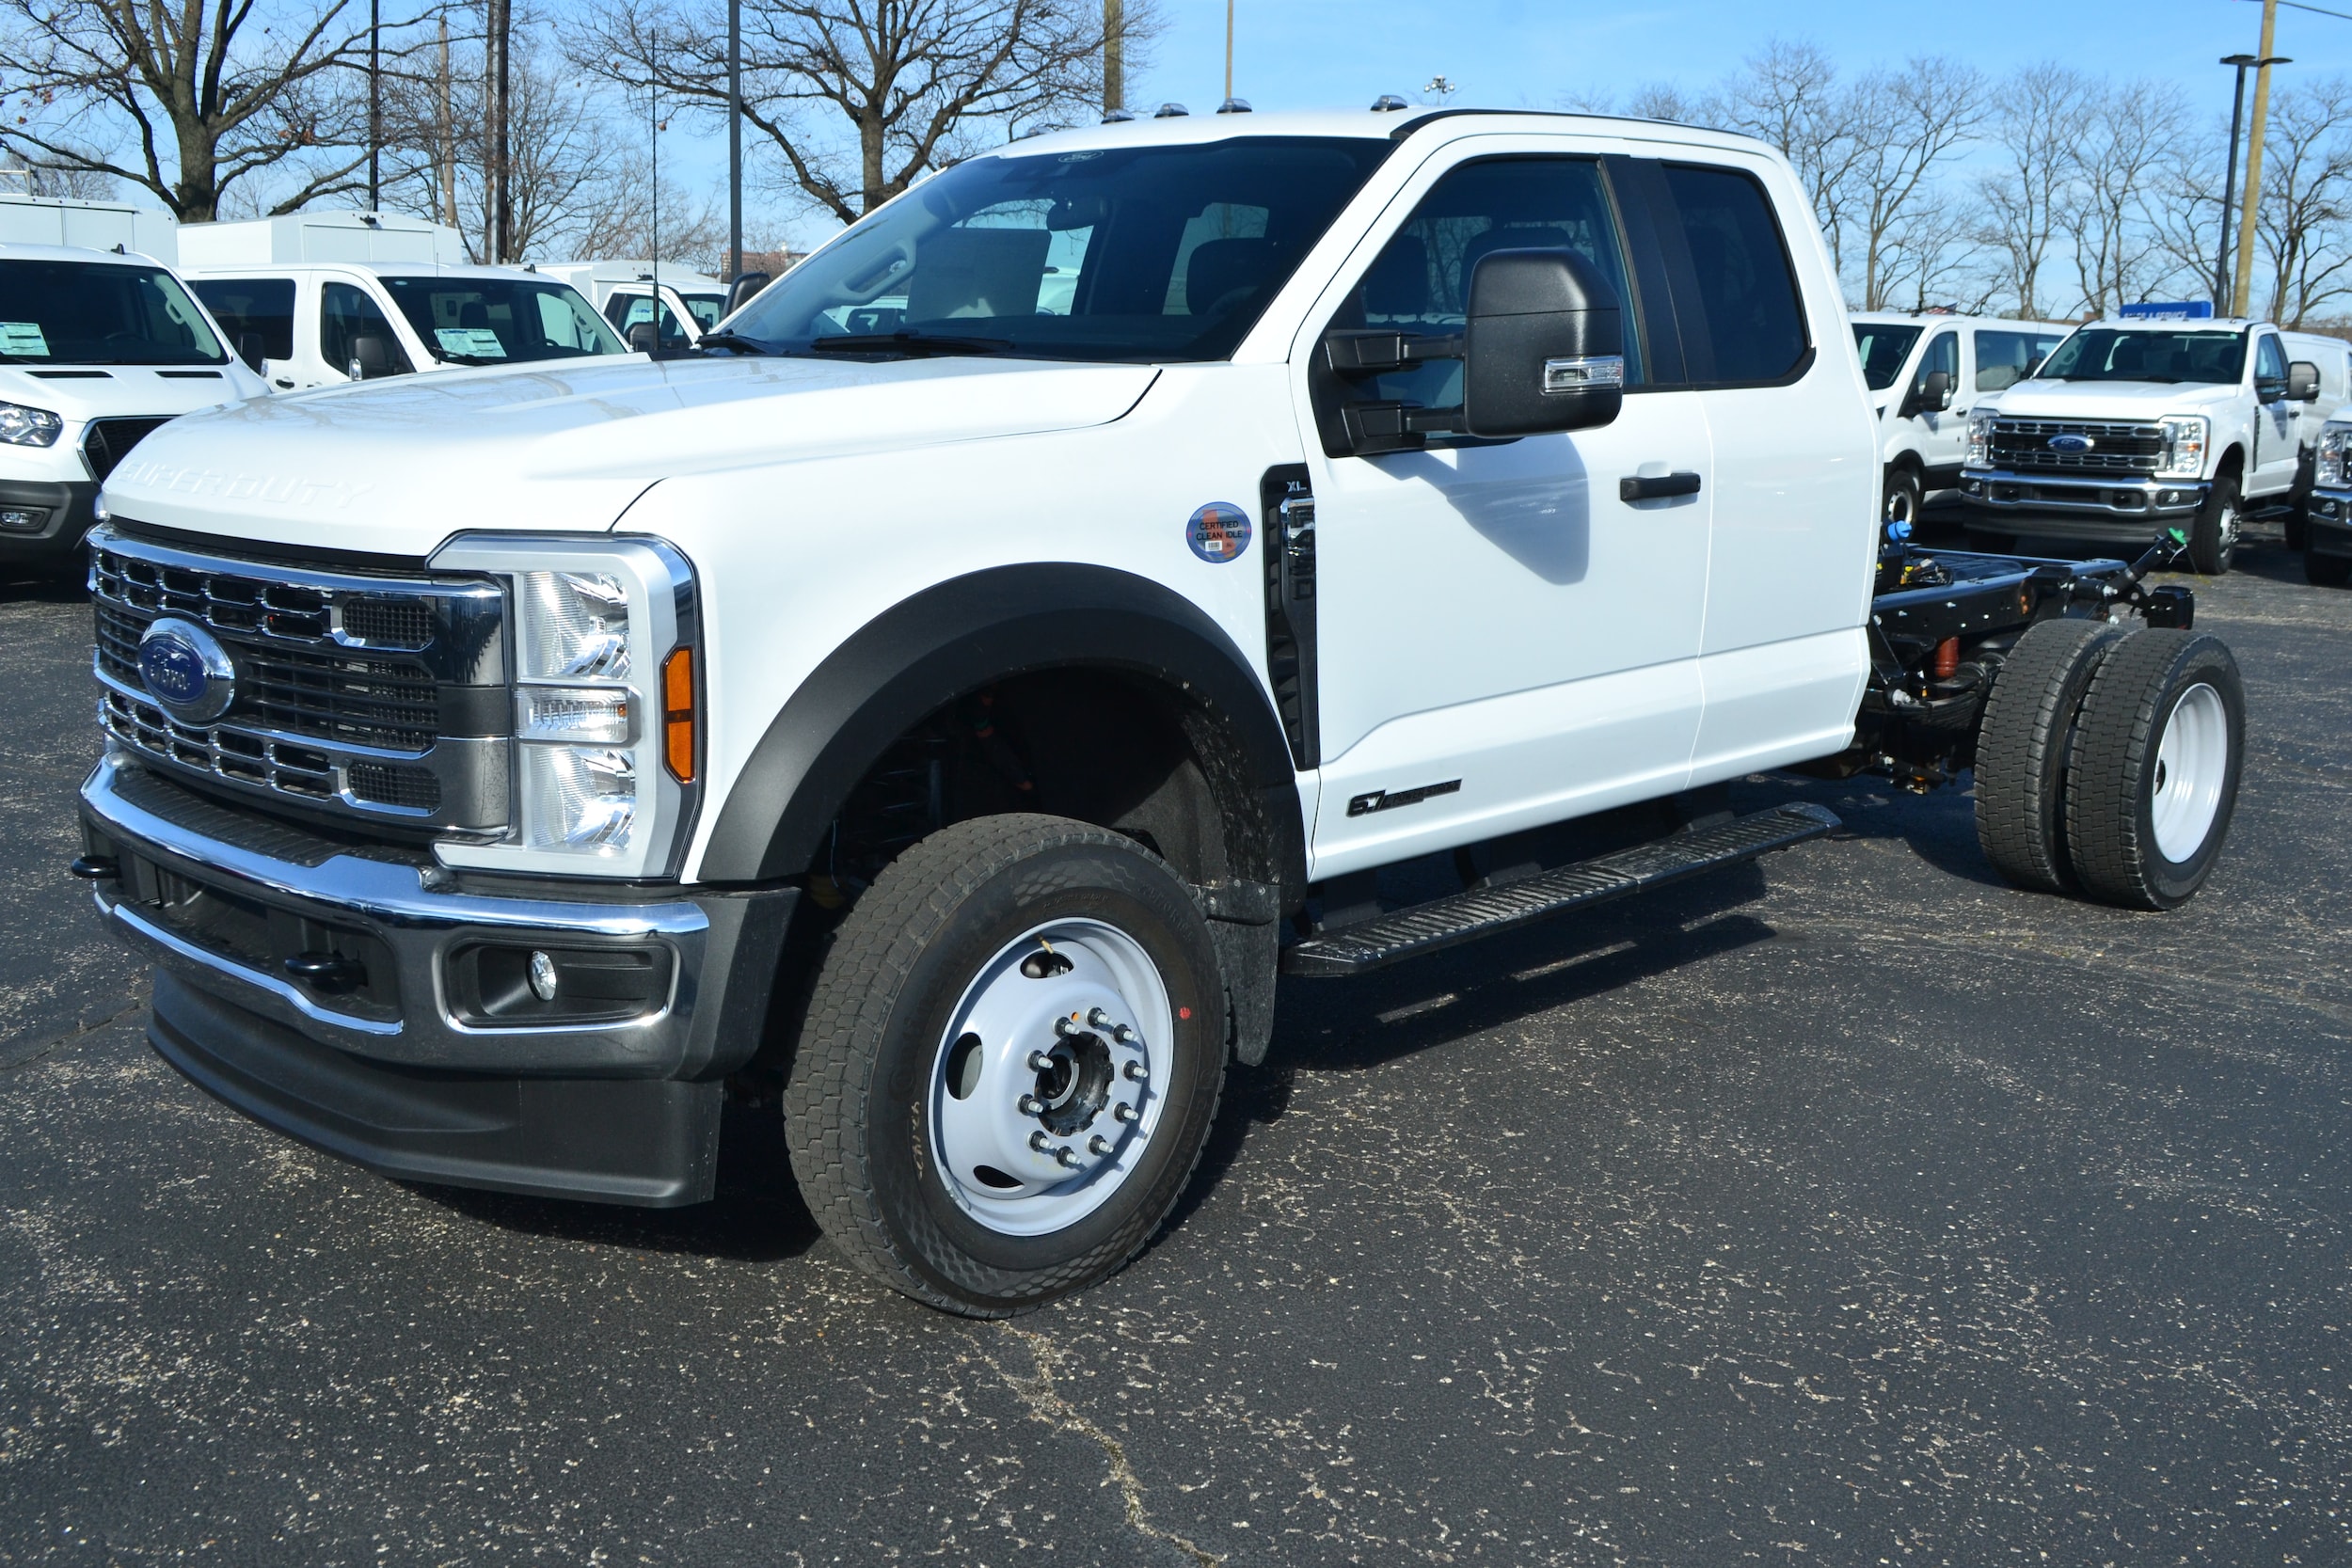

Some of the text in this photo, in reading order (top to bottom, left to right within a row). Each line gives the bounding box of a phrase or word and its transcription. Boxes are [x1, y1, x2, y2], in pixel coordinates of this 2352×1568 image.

[117, 459, 375, 509] SUPER DUTY
[1286, 481, 1308, 492] XL
[1199, 520, 1239, 531] CERTIFIED
[1196, 530, 1243, 541] CLEAN IDLE
